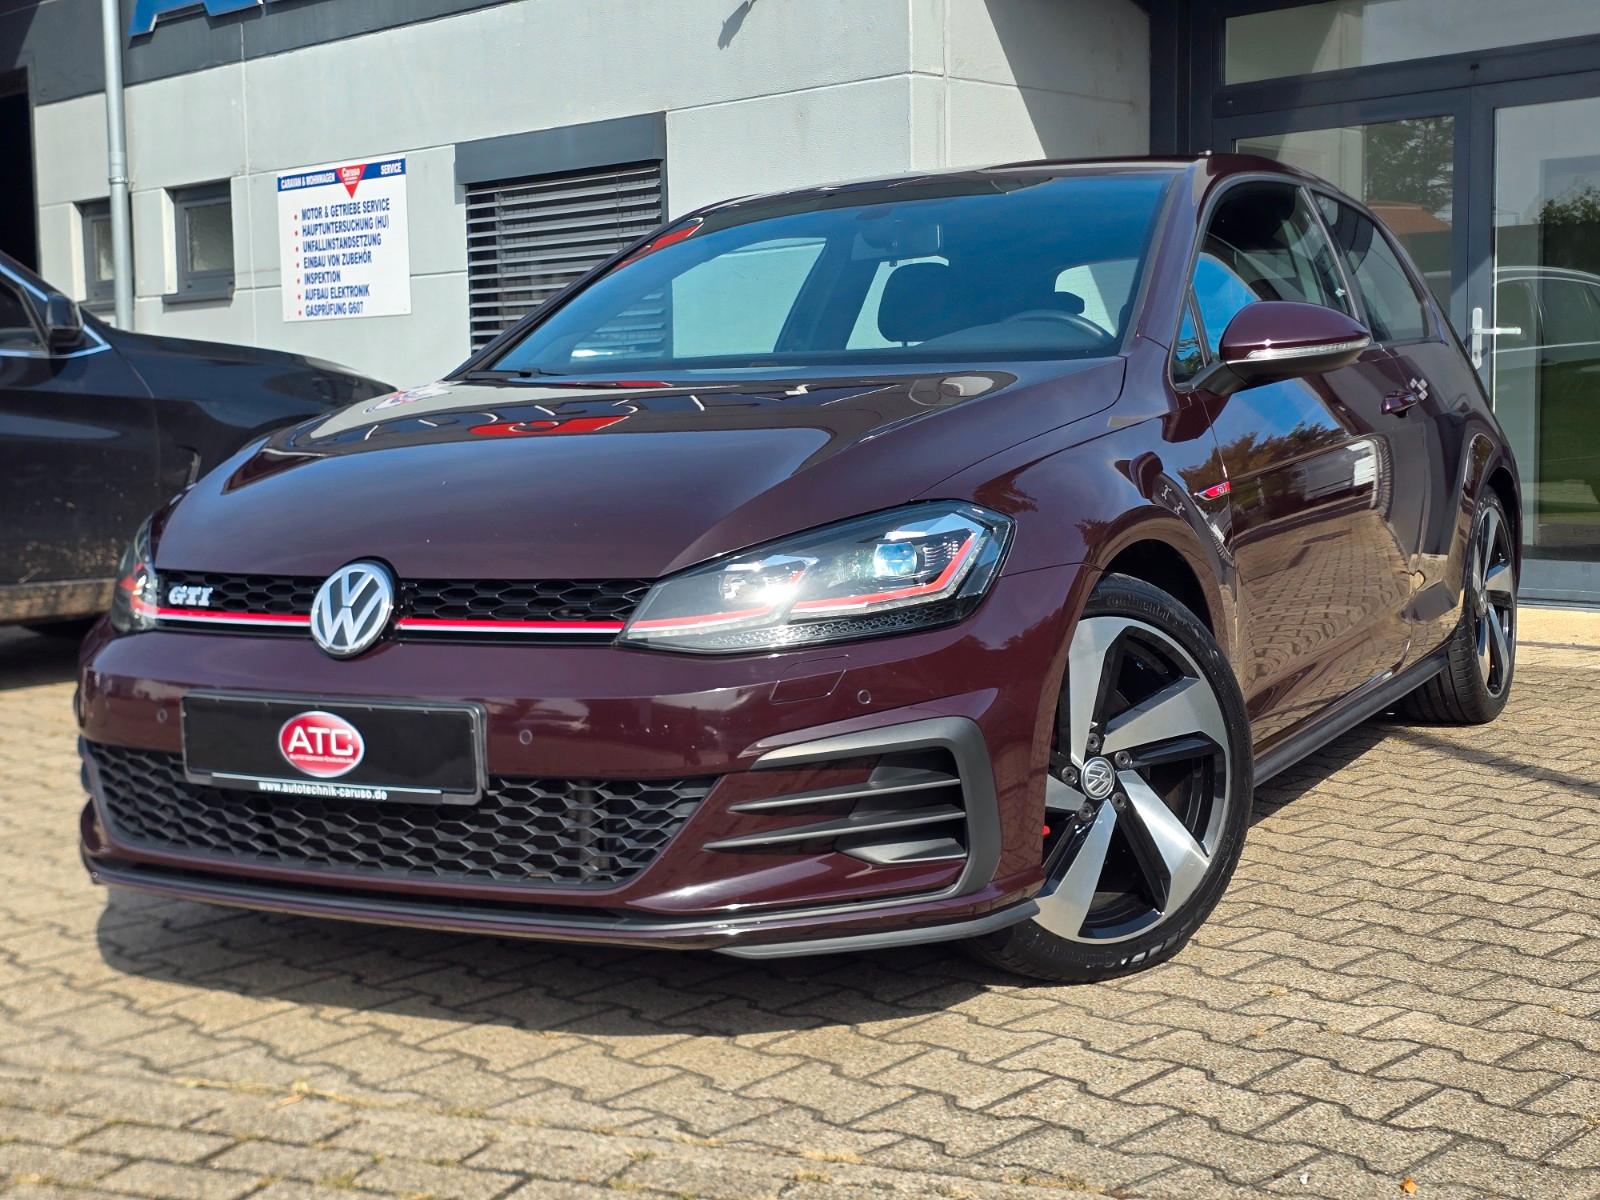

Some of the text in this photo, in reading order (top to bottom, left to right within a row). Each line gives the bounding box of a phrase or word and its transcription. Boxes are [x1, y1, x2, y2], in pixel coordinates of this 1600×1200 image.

[380, 162, 402, 175] SERVICE
[302, 198, 390, 220] MOTOR & GETRIEBE SERVICE
[302, 215, 390, 237] HAUPTUNTERSUCHUNG (HU)
[303, 233, 382, 252] UNFALLINSTANDSETZUNG
[304, 249, 372, 269] EINBAU VON ZUBEHÖR
[304, 271, 341, 285] INSPEKTION
[305, 284, 370, 300] AUFBAU ELEKTRONIK
[306, 301, 364, 317] GASPRÜFUNG G607
[168, 585, 214, 607] GTI
[288, 725, 354, 756] ATC
[258, 781, 388, 801] www.autotechnik-caruso.de
